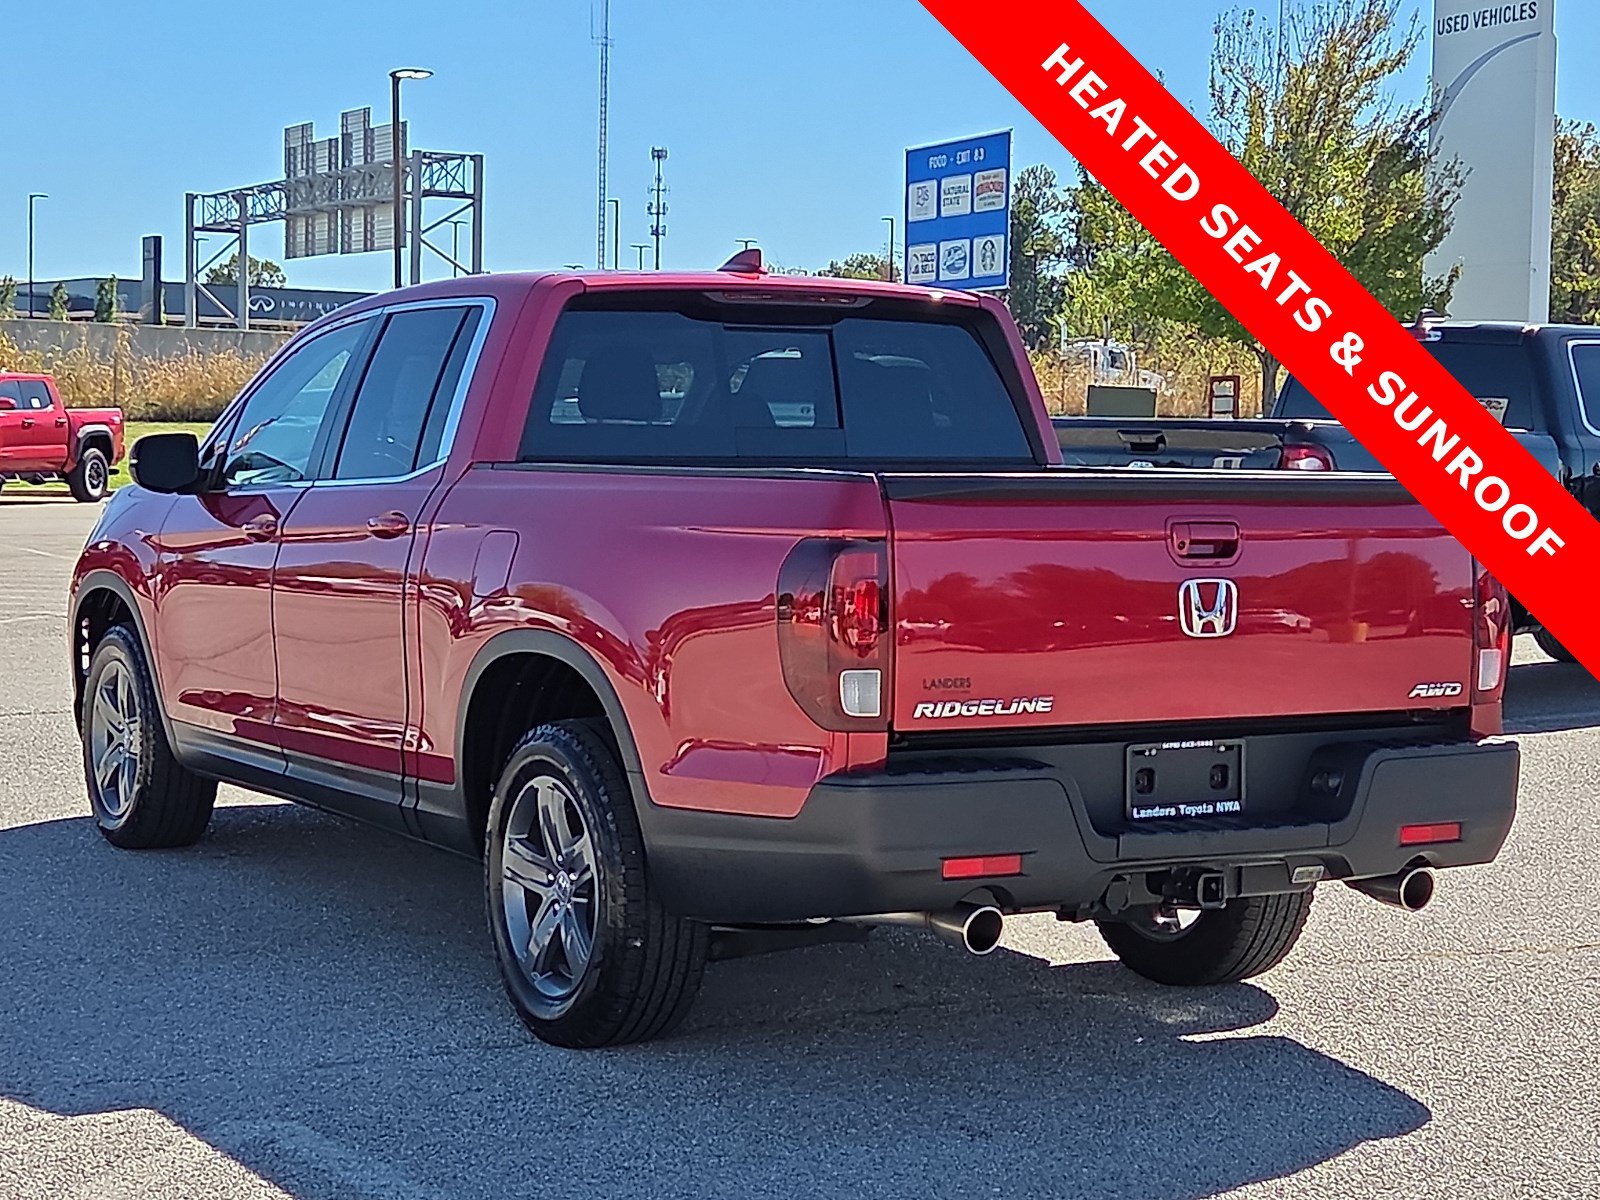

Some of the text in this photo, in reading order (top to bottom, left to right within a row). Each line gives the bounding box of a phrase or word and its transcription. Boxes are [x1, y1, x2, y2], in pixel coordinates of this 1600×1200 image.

[1437, 1, 1537, 35] USED VEHICLES
[928, 155, 946, 169] FOOD
[943, 185, 969, 196] NATURAL
[942, 197, 960, 207] STATE
[281, 300, 340, 310] INFINIT
[922, 677, 972, 690] LANDERS
[1408, 682, 1462, 698] AWD
[913, 695, 1054, 718] RIDGELINE
[1132, 801, 1241, 818] Landers Toyota NWA
